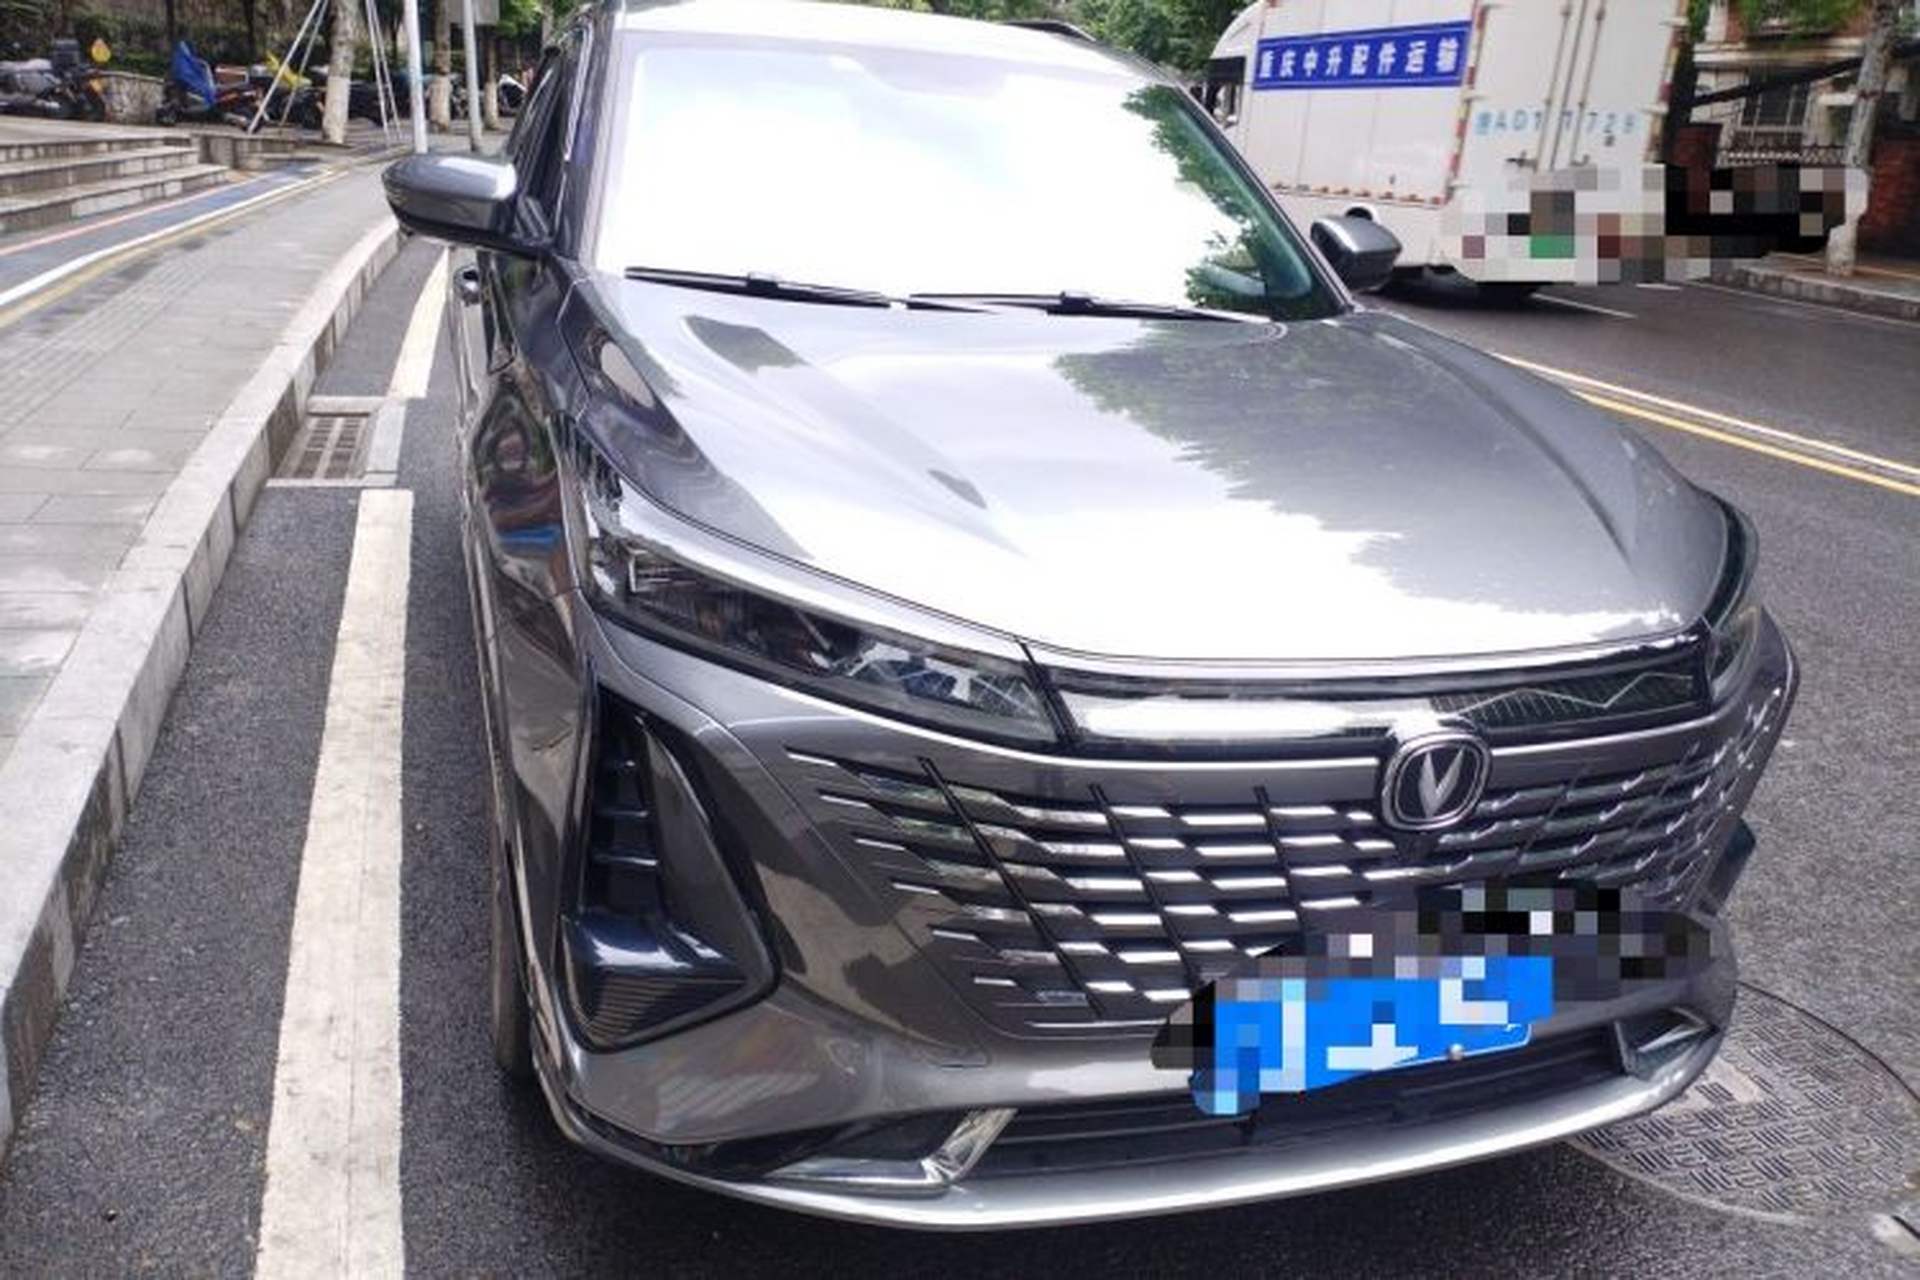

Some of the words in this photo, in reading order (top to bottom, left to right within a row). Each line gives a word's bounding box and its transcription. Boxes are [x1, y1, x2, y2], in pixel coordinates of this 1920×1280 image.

[1258, 37, 1460, 79] 重庆中升配件运输
